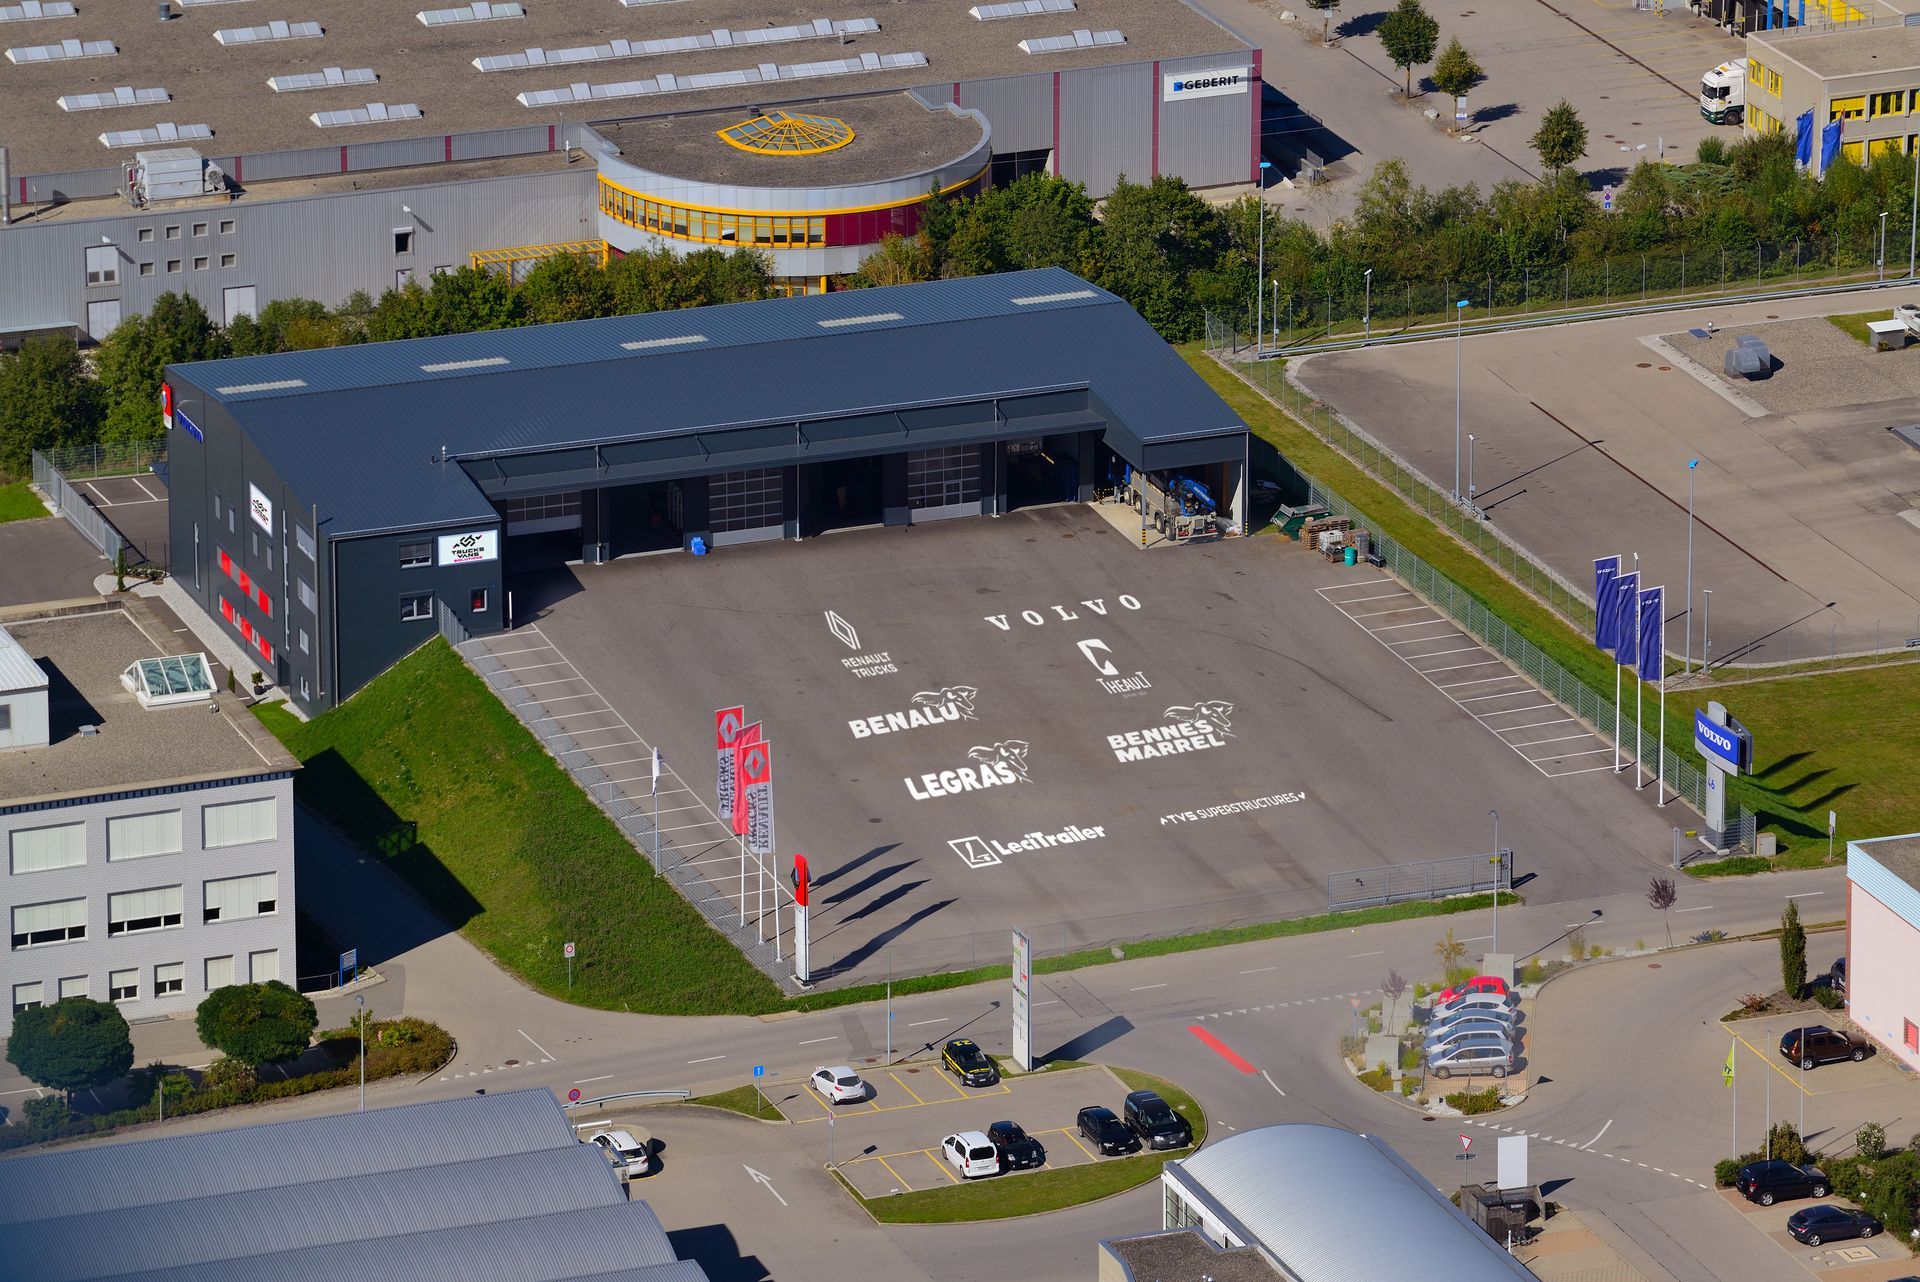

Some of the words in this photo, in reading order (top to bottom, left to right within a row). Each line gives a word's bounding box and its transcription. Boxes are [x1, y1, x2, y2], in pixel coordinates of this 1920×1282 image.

[1184, 75, 1239, 90] GEBERIT
[451, 546, 485, 555] TRUCKS
[984, 594, 1142, 631] VOLVO
[841, 652, 891, 669] RENAULT
[851, 663, 898, 679] TRUCKS
[848, 701, 961, 739] BENALU
[1106, 719, 1215, 749] BENNES
[1697, 719, 1732, 751] VOLVO
[1114, 733, 1226, 763] MARREL
[903, 760, 1018, 801] LEGRAS
[1166, 811, 1199, 825] TVS
[1198, 792, 1300, 819] SUPERSTRUCTURES
[991, 824, 1107, 856] LeciTrailer
